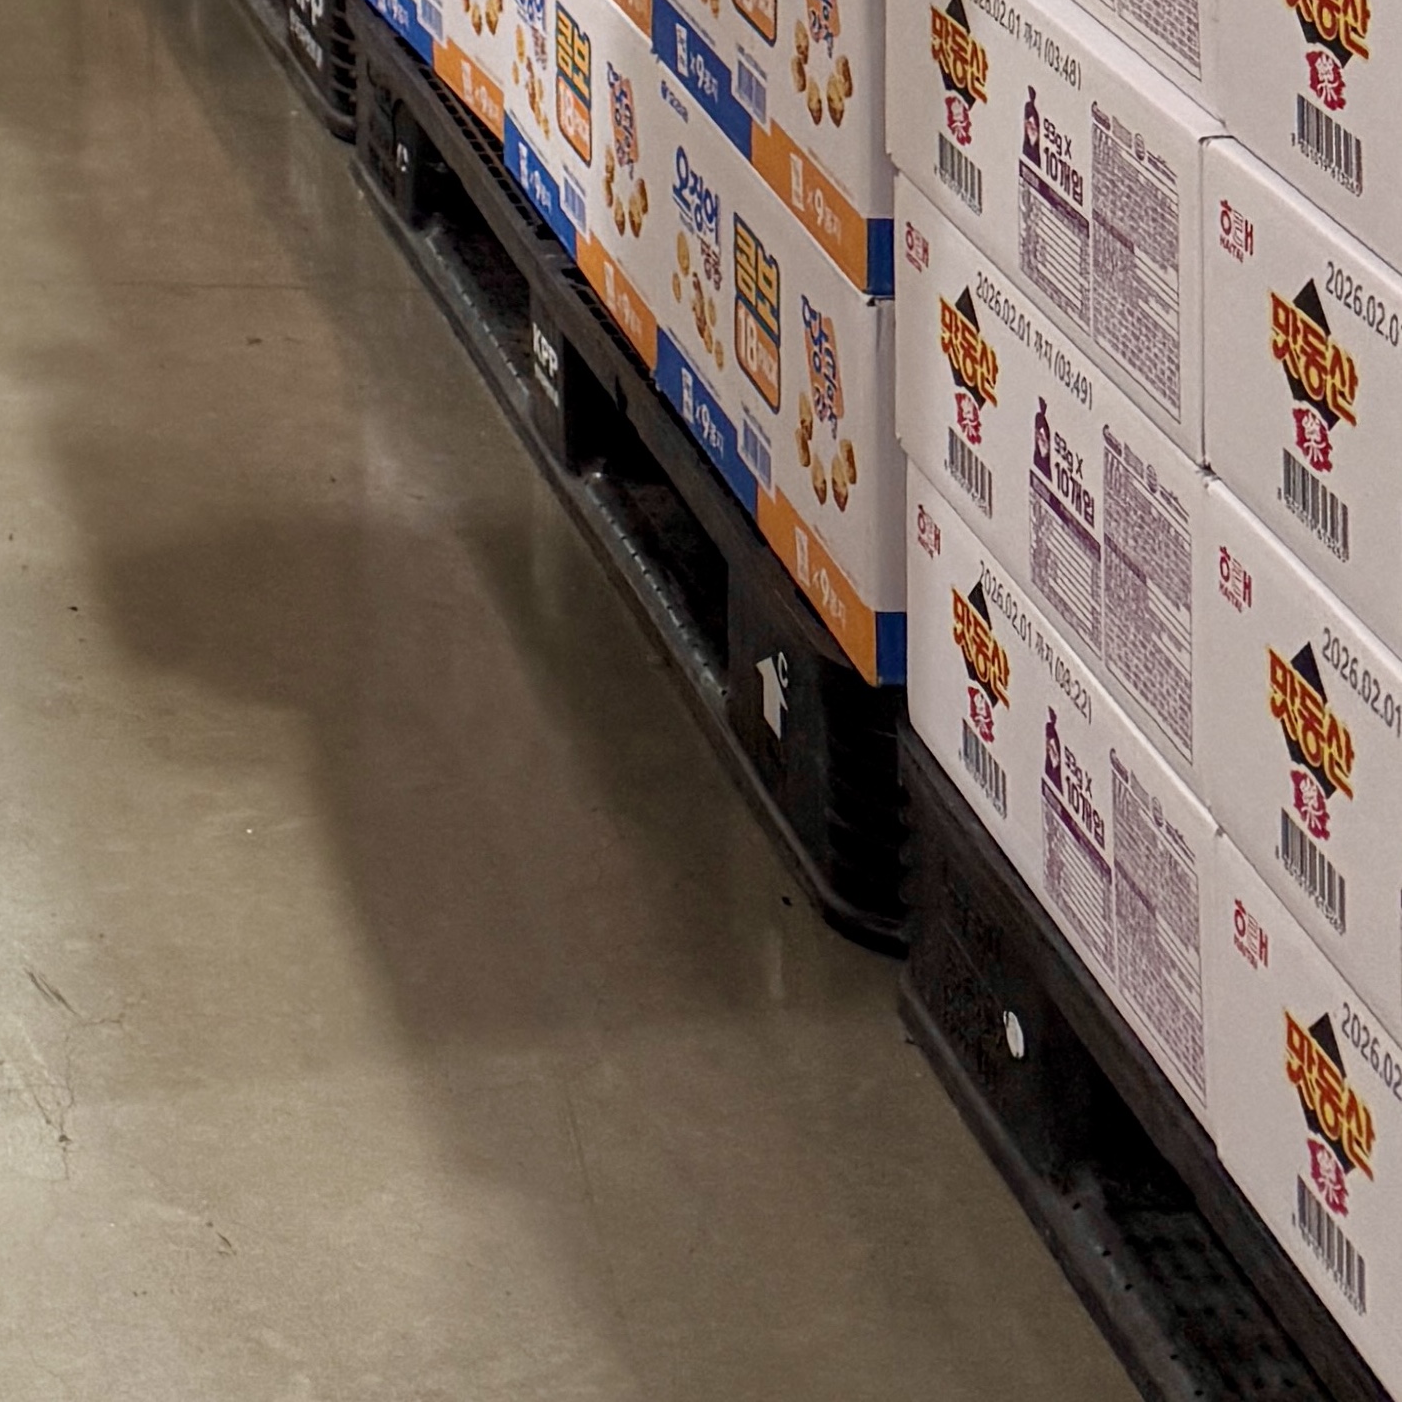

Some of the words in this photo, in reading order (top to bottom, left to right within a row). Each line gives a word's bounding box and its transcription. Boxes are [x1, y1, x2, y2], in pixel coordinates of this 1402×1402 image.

[930, 3, 988, 105] 맛동산
[1044, 37, 1083, 92] (03:48)
[1043, 145, 1084, 207] 10개입
[532, 322, 559, 378] KPP
[735, 300, 759, 372] 18
[939, 295, 1000, 408] 맛동산
[975, 270, 1031, 347] 2026.02.01
[1052, 348, 1093, 411] (03:49)
[1268, 287, 1359, 428] 맛동산
[1053, 461, 1096, 530] 10개입
[979, 559, 1033, 651] 2026.02.01
[1266, 645, 1355, 802] 맛동산
[1284, 1006, 1376, 1183] 맛동산
